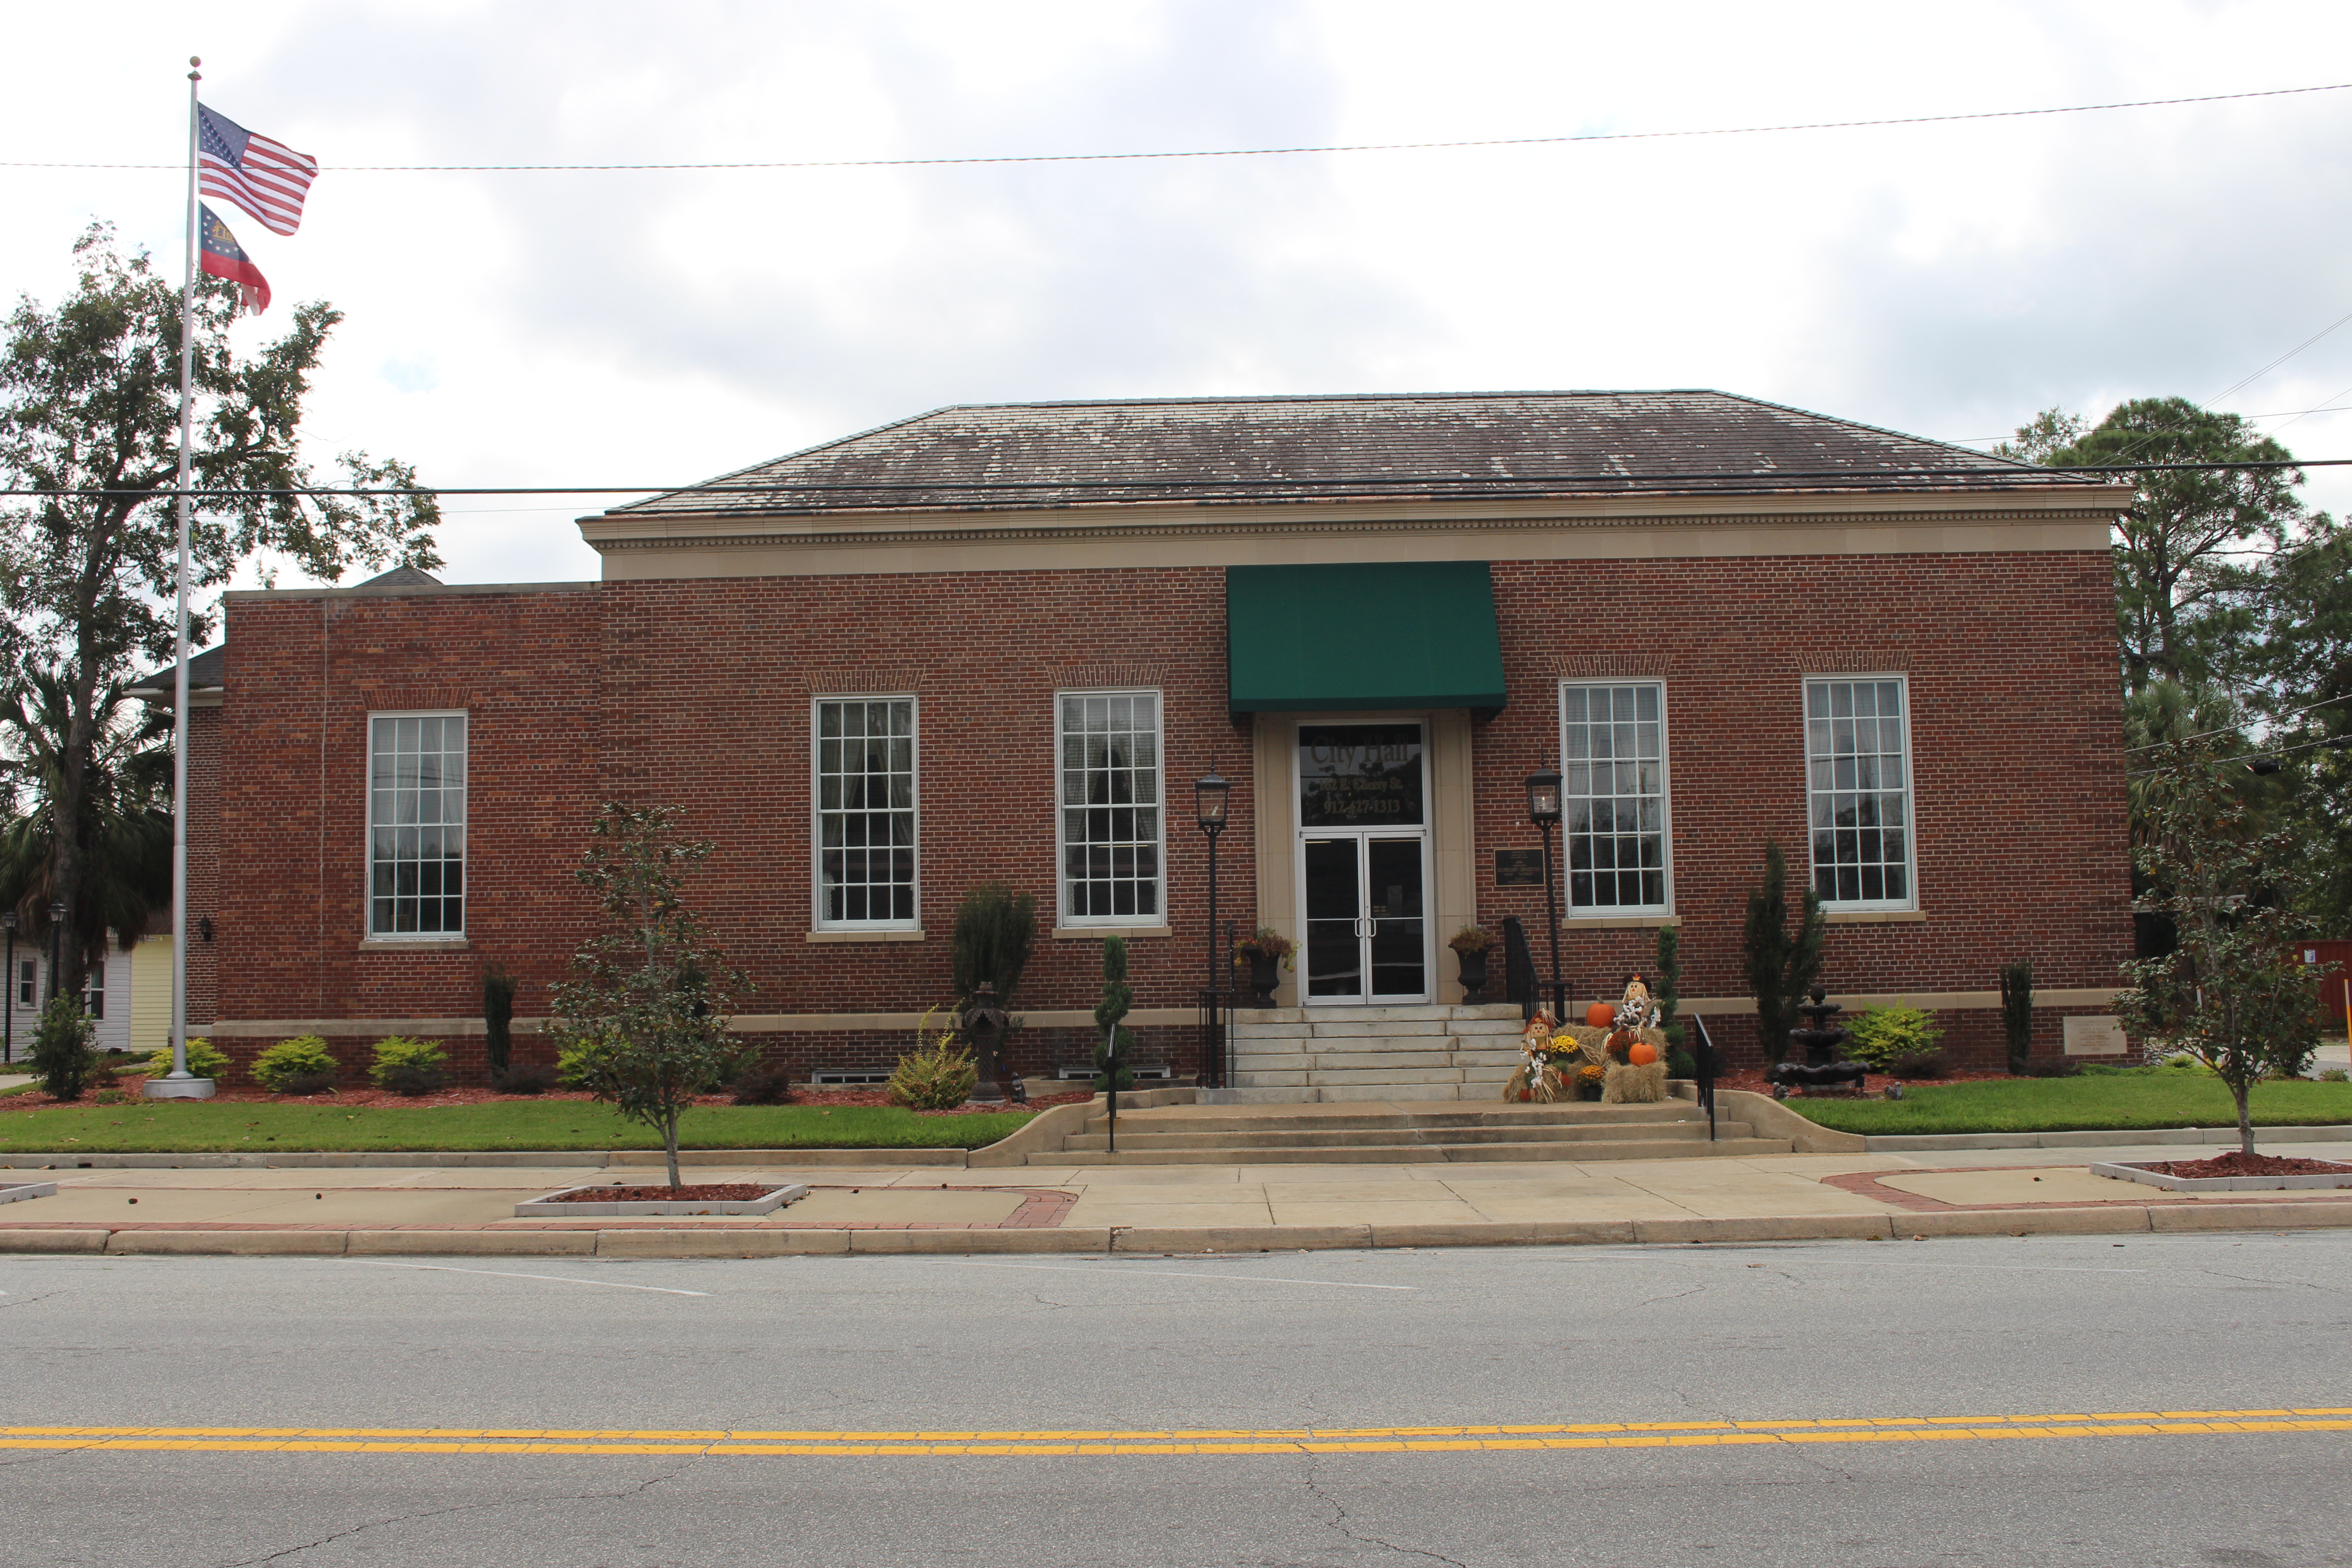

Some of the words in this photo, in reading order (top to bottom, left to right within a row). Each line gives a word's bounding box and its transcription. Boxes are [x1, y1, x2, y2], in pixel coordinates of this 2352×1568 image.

[1310, 736, 1357, 769] City
[1362, 734, 1409, 762] Hall
[1319, 778, 1338, 791] 162
[1340, 778, 1351, 791] E.
[1353, 777, 1387, 792] Cherry
[1390, 776, 1404, 789] St.
[1324, 799, 1401, 814] 912-427-1313
